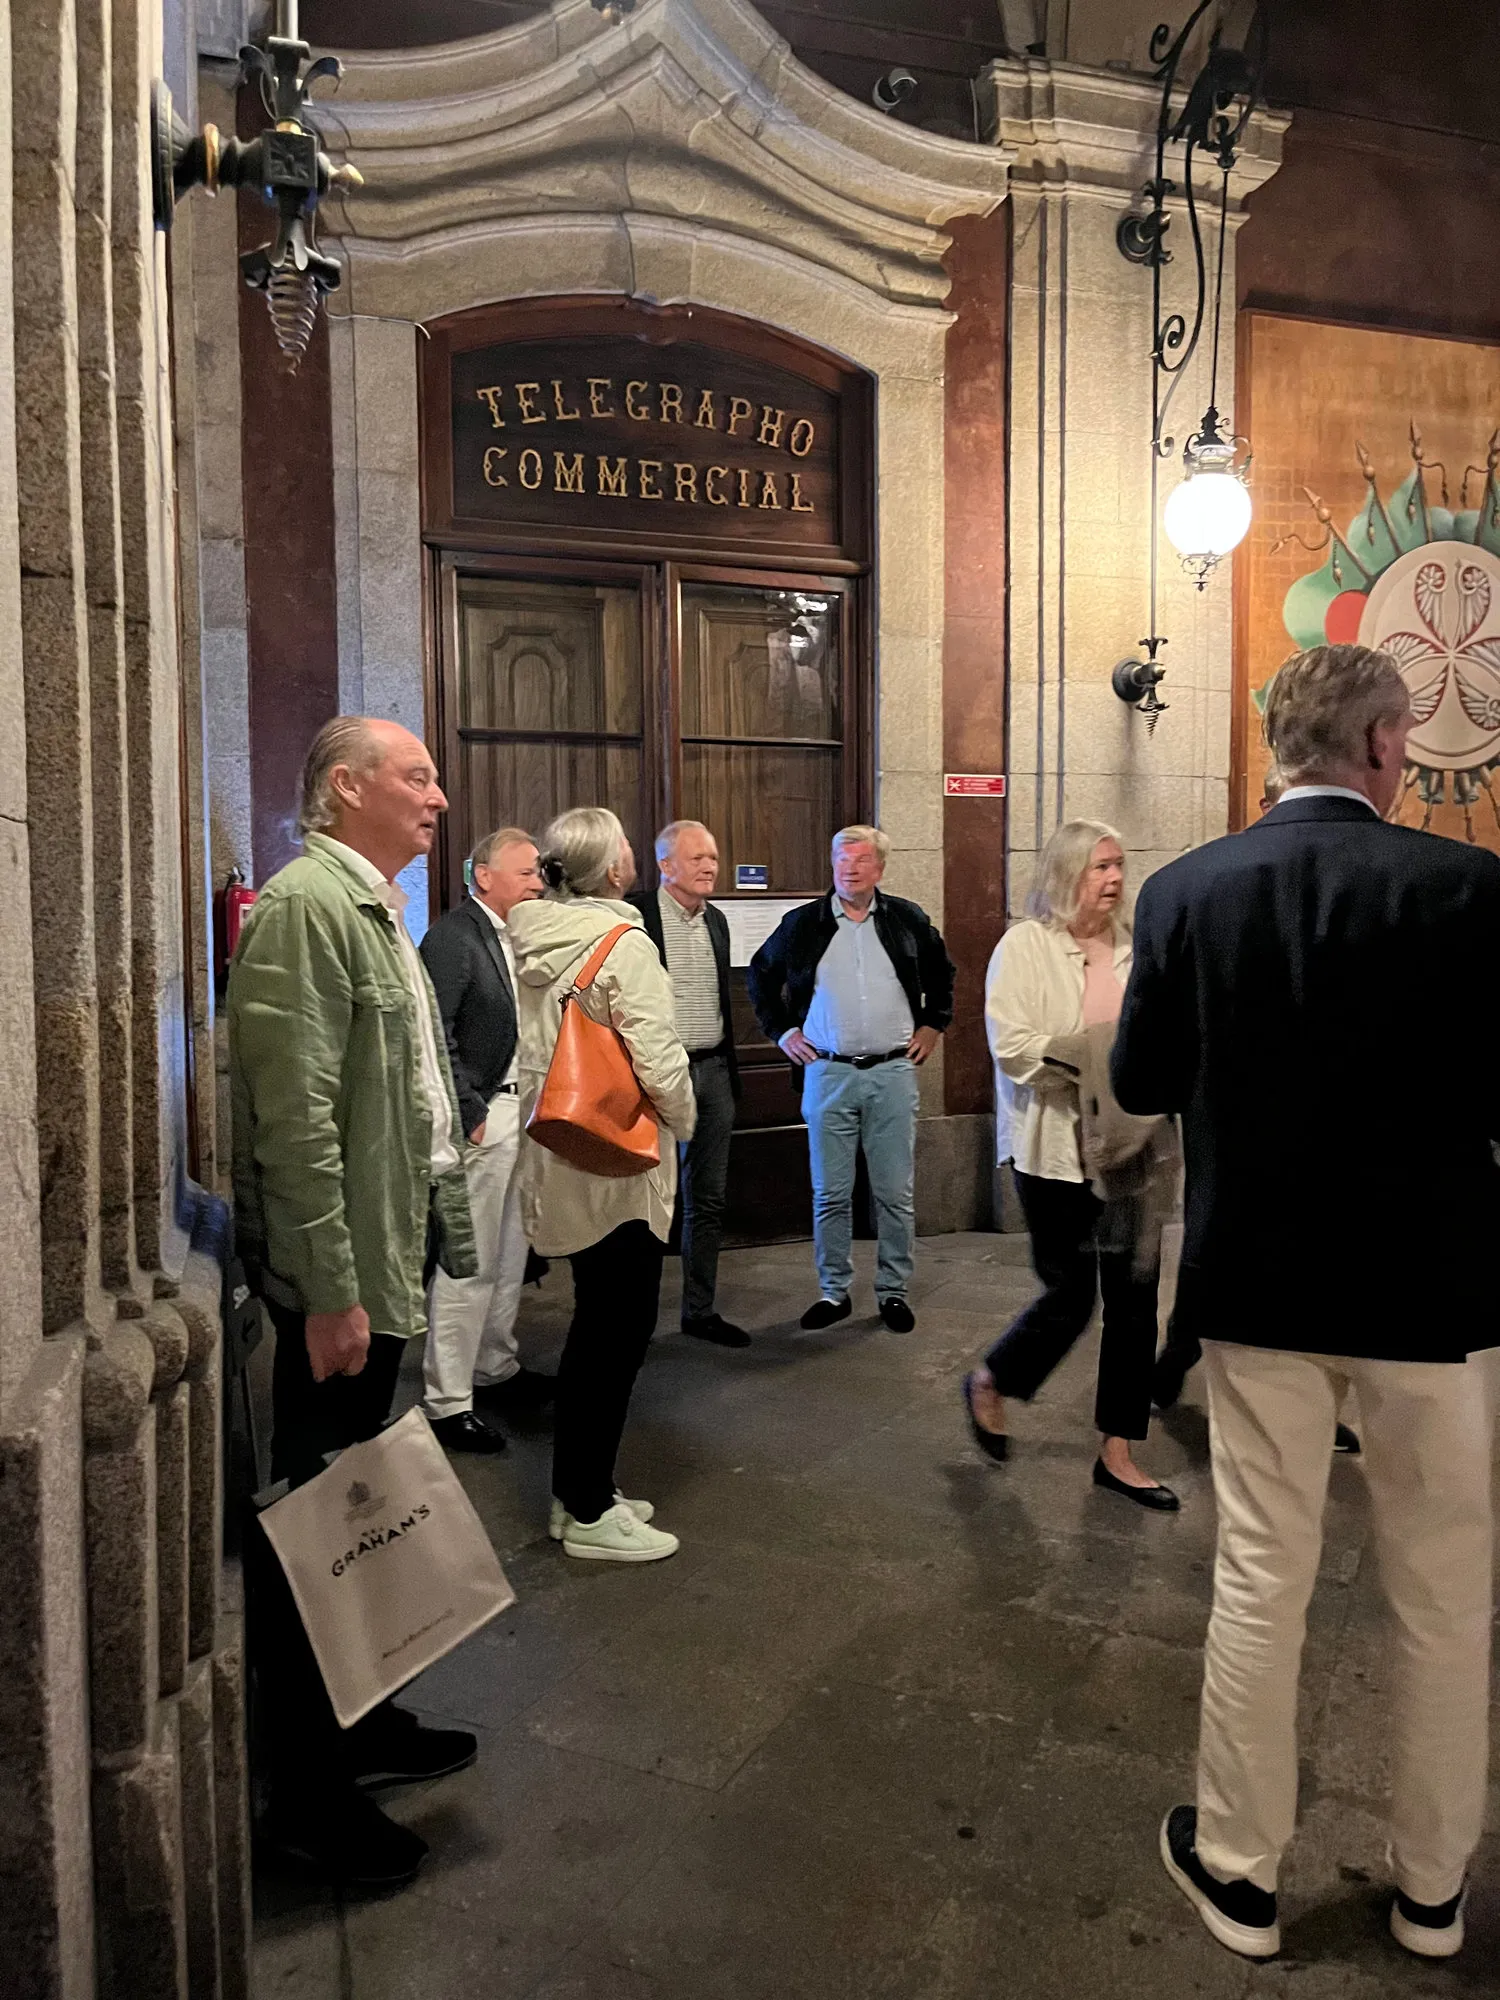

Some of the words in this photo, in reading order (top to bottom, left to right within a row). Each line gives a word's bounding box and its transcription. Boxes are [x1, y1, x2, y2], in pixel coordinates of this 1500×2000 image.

[477, 378, 815, 457] TELEGRAPHO
[483, 446, 815, 513] COMMERCIAL
[331, 1504, 431, 1577] GRAHAM'S
